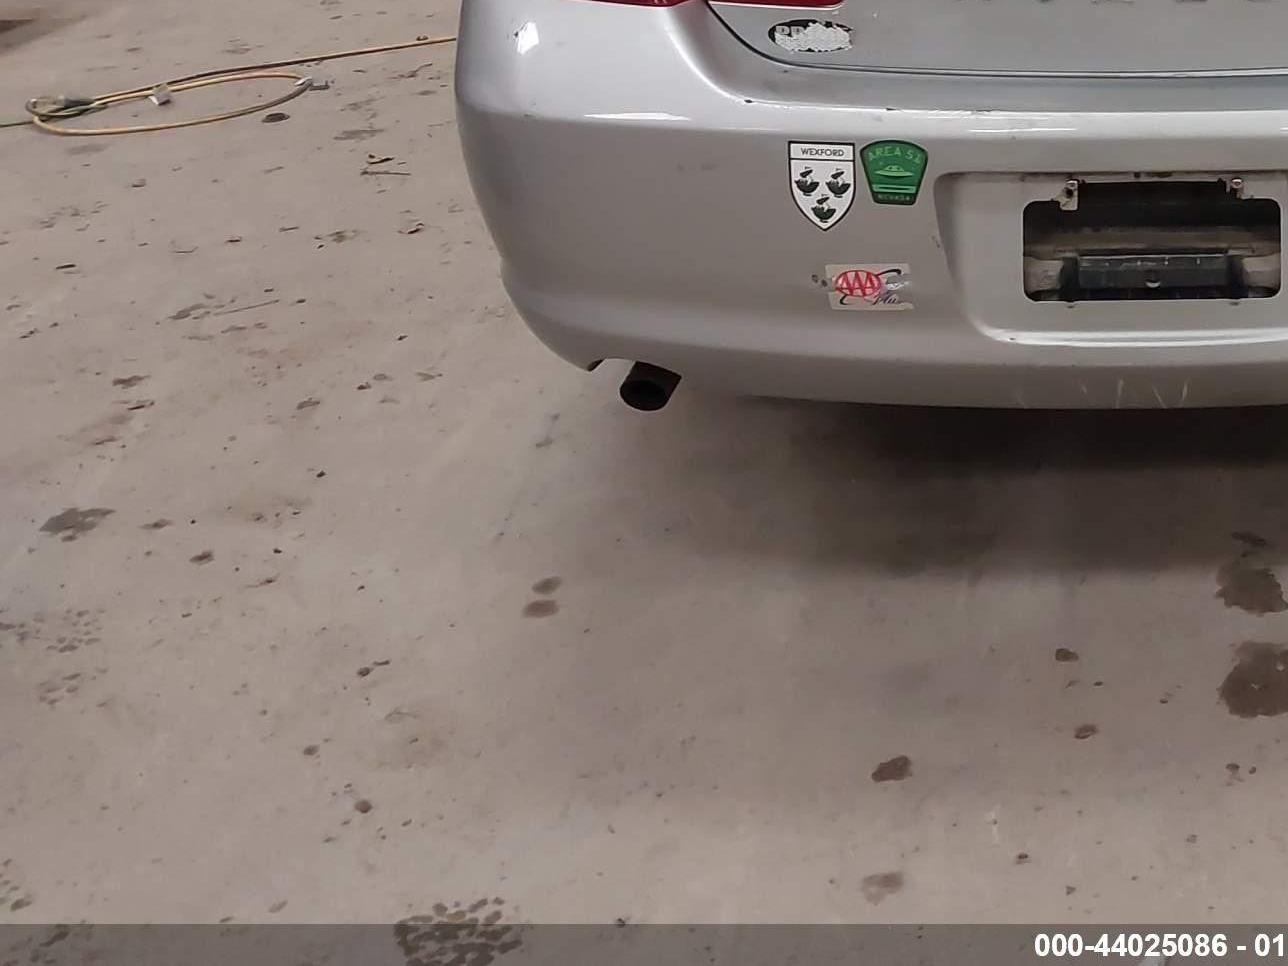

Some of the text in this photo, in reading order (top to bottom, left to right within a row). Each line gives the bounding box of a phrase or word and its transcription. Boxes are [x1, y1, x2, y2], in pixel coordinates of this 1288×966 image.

[800, 147, 845, 157] WEXFORD
[868, 146, 903, 161] AREA
[836, 272, 878, 296] AAA
